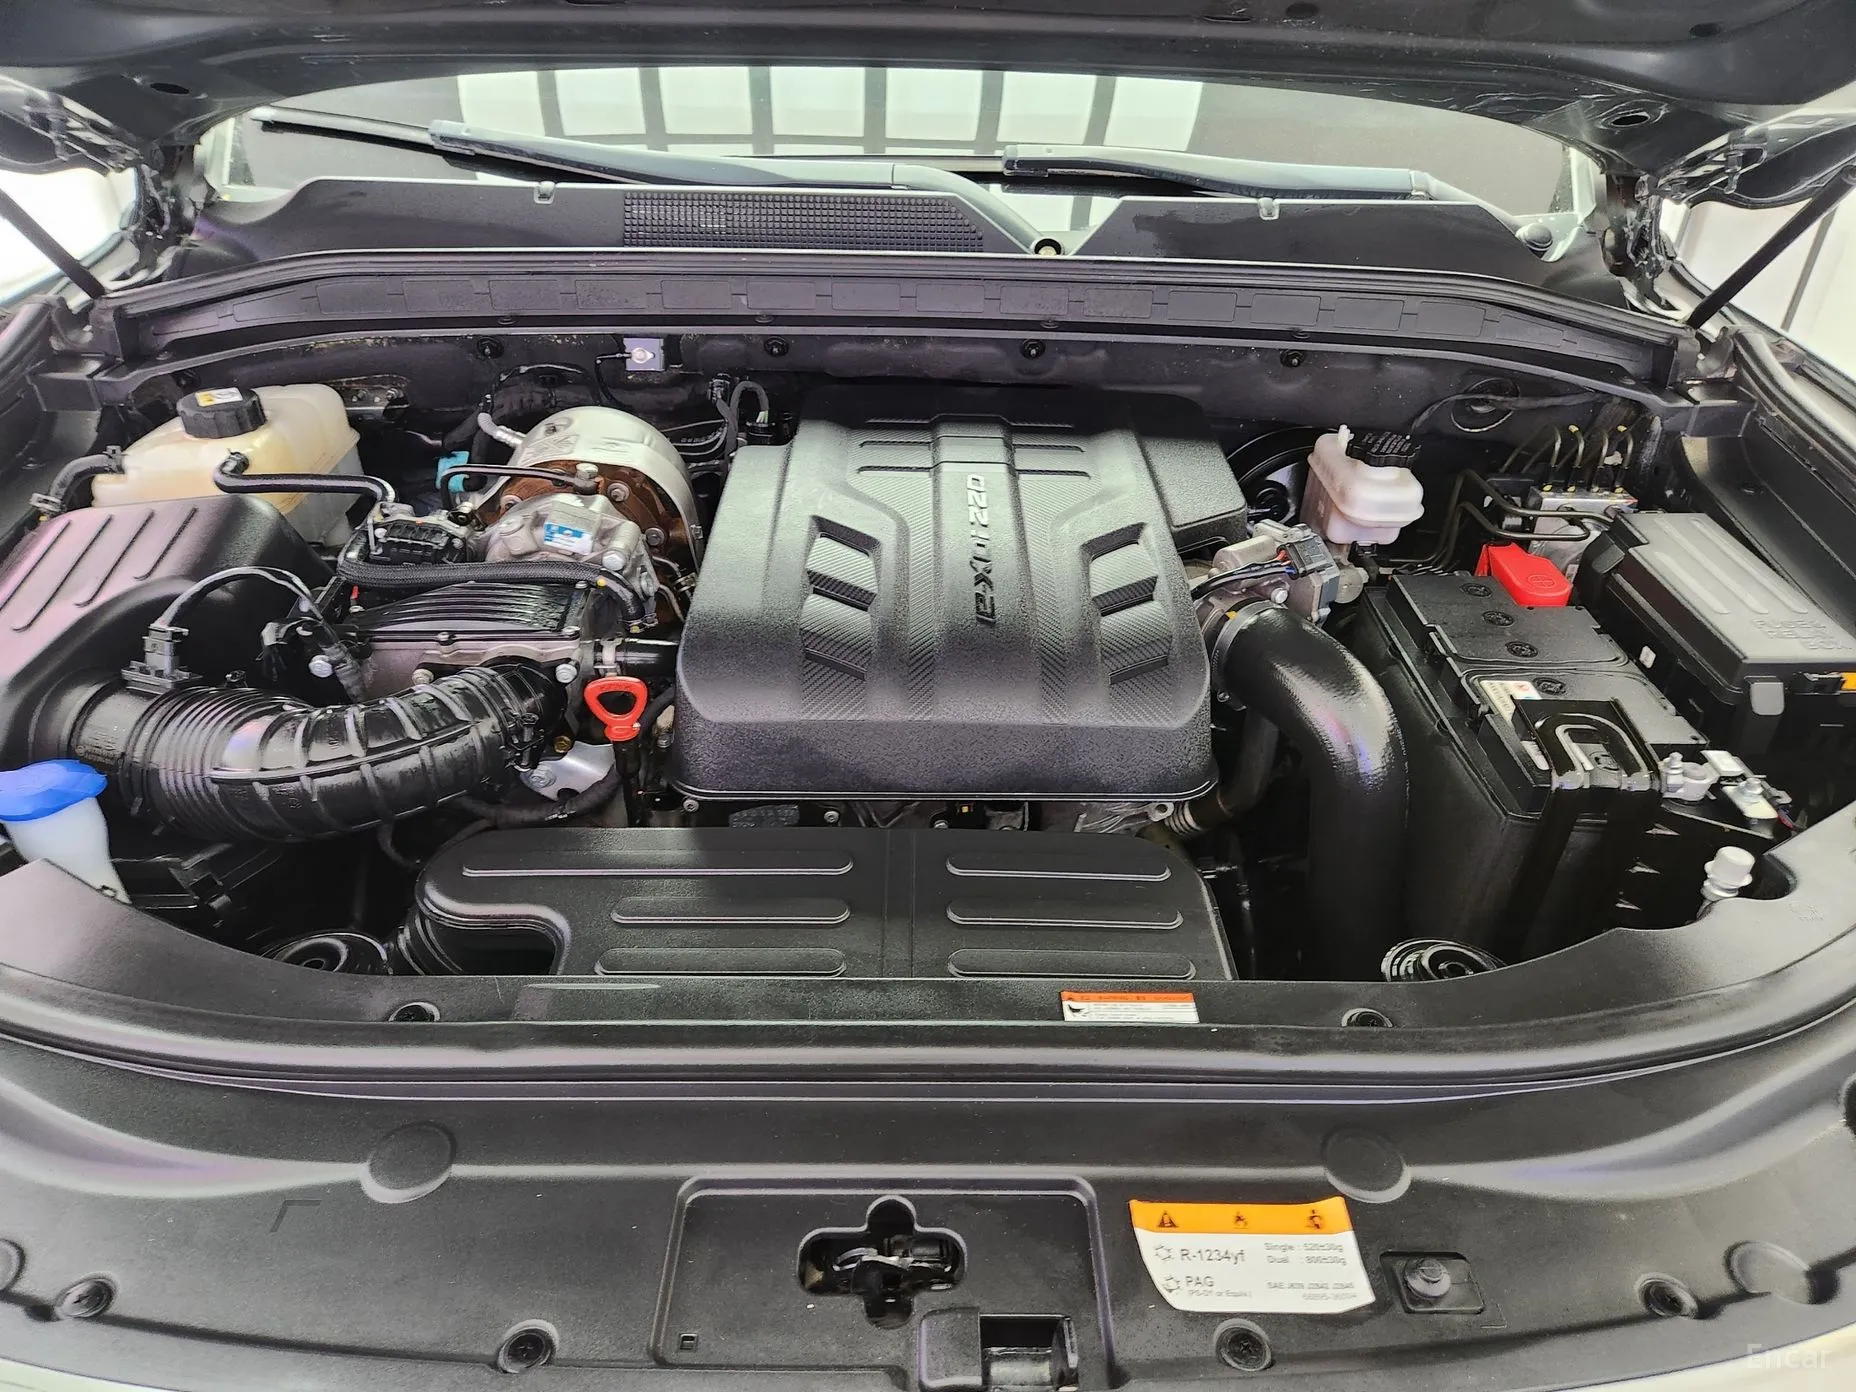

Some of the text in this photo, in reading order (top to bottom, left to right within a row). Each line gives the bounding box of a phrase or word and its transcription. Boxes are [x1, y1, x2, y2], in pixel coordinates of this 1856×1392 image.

[1264, 1242, 1295, 1253] Single
[1180, 1248, 1246, 1265] R-1234yf
[1267, 1255, 1289, 1264] Dual
[1185, 1275, 1215, 1287] PAG
